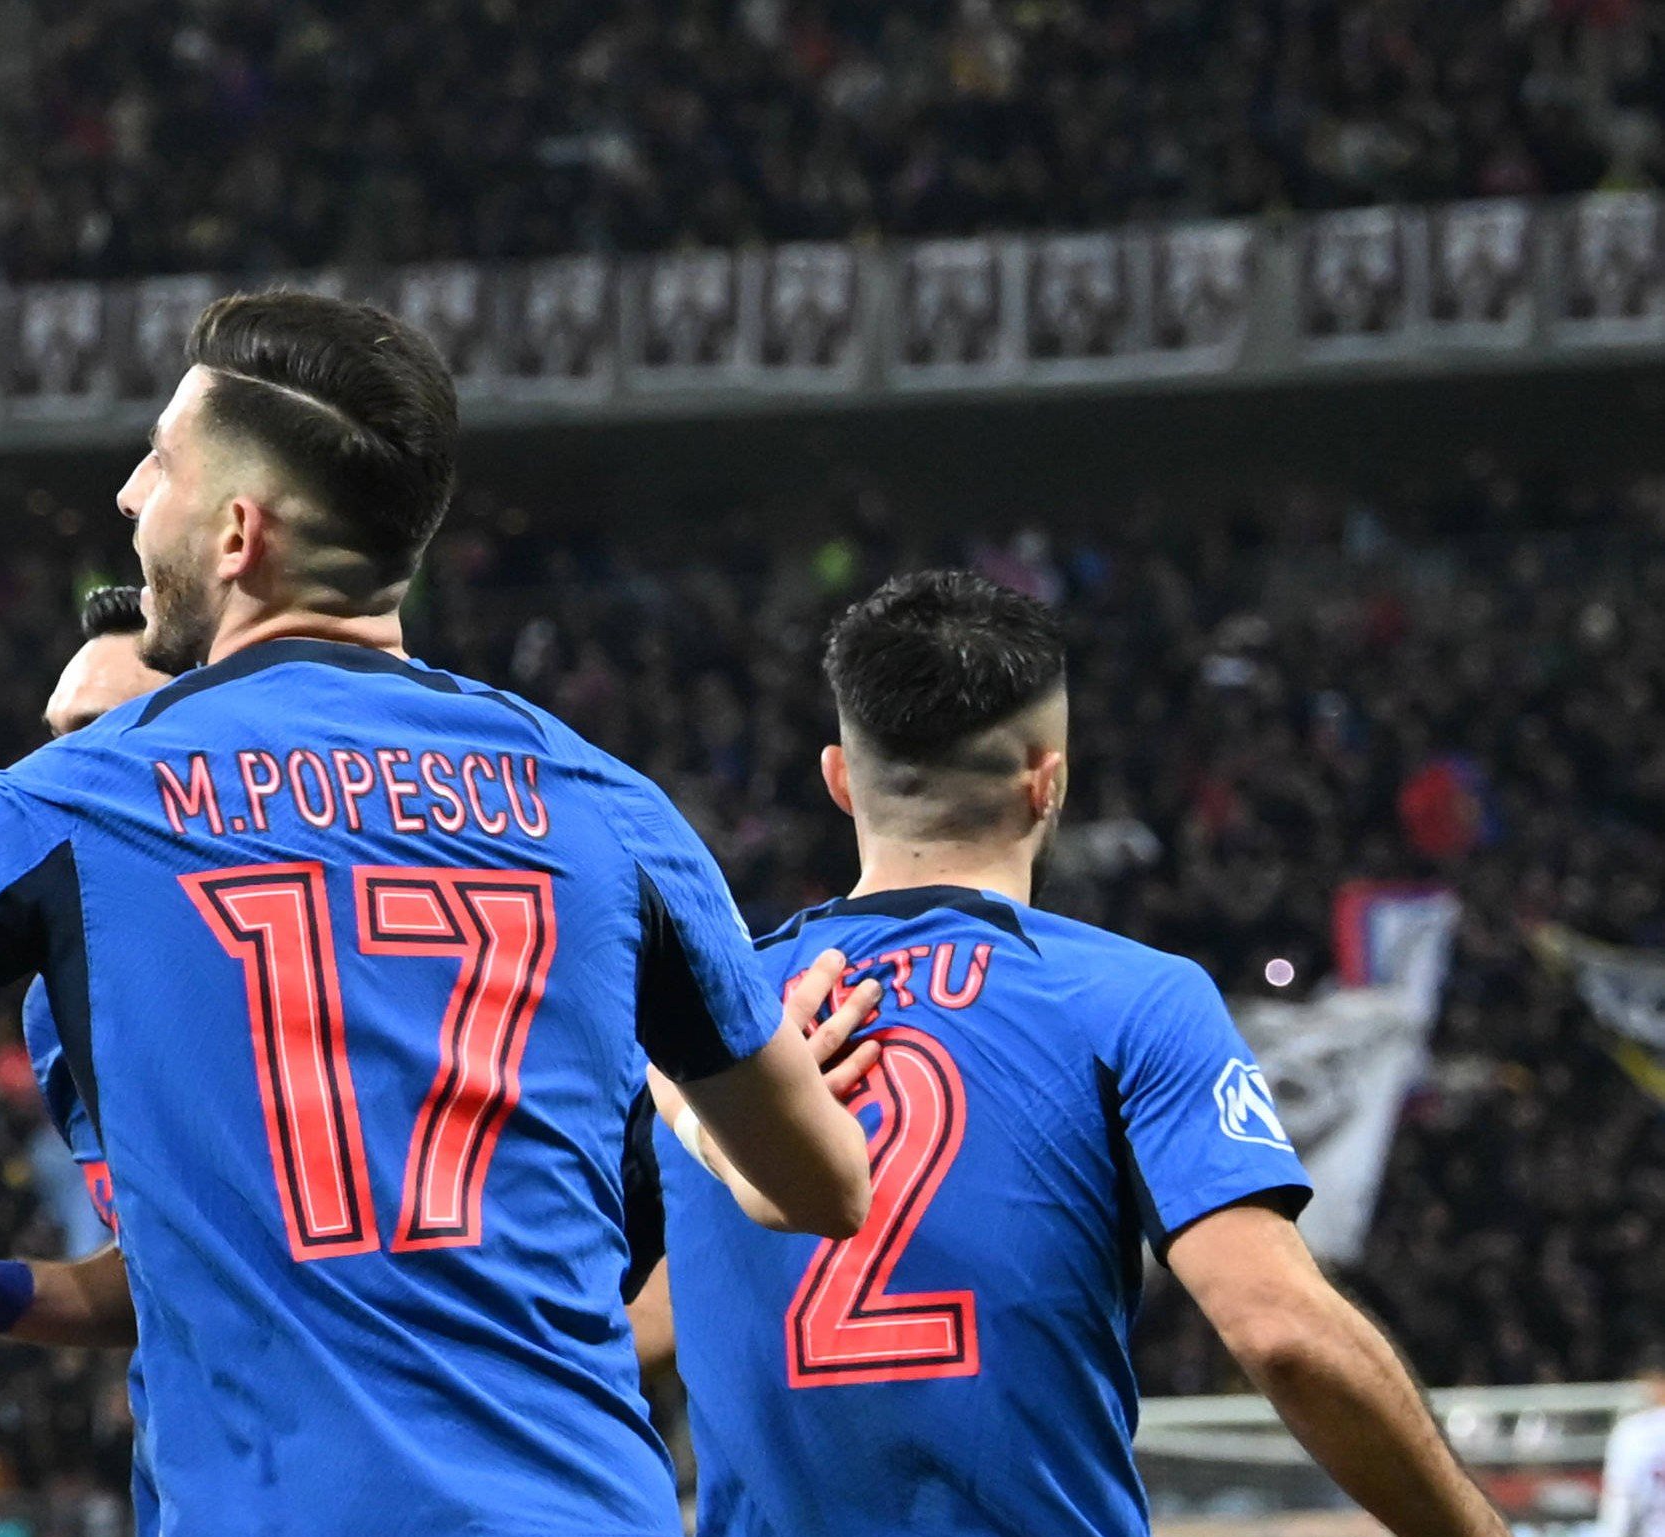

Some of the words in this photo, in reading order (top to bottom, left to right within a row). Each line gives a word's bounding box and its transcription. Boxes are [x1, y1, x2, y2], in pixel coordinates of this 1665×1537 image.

[155, 749, 551, 839] M.POPESCU
[177, 861, 559, 1262] 17
[785, 1025, 979, 1389] 2
